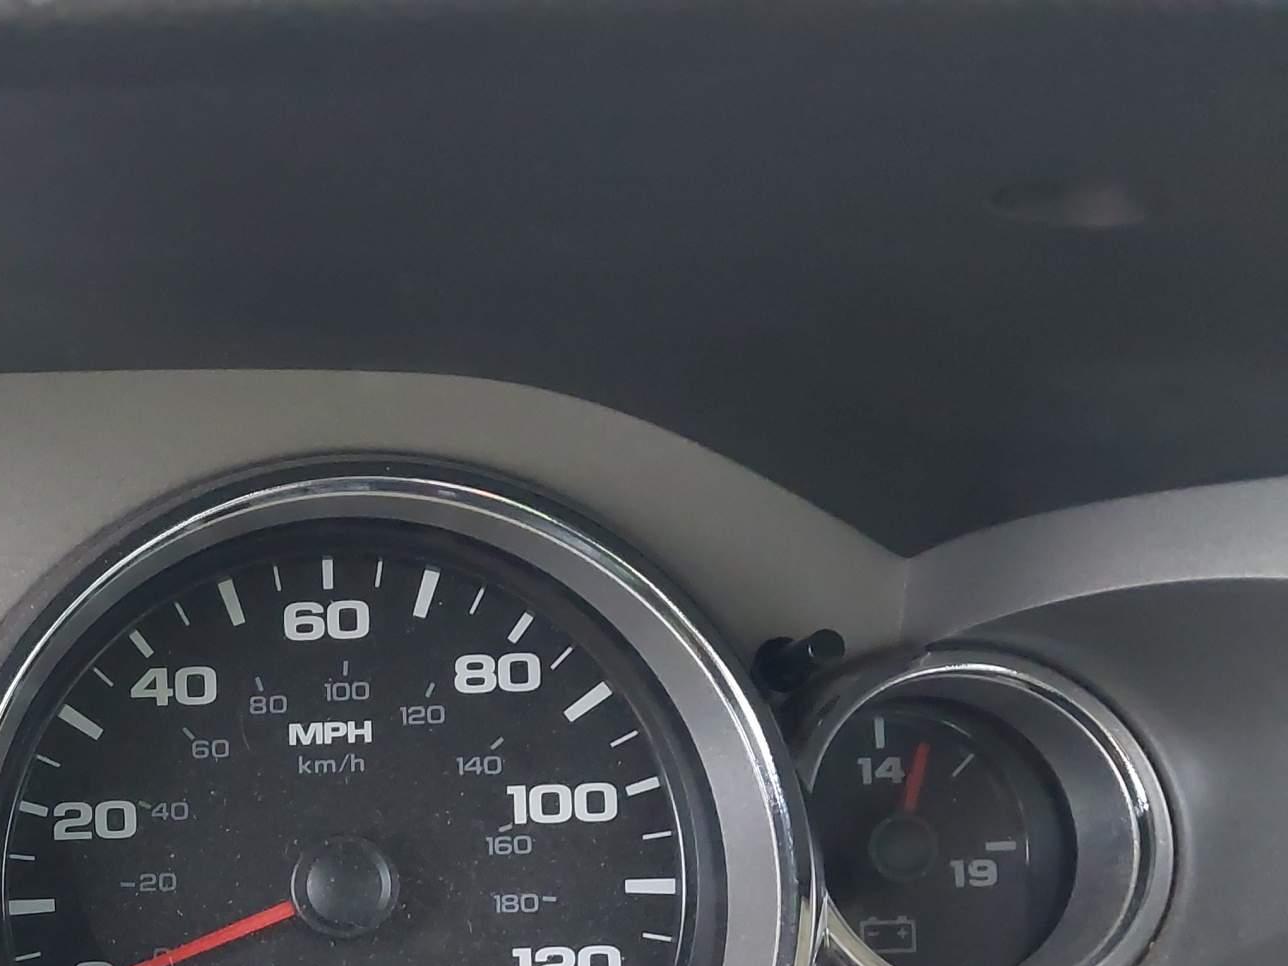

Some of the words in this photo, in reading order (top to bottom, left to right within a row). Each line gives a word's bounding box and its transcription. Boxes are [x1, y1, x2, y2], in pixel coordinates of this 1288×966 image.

[283, 600, 370, 642] 60
[454, 653, 541, 694] 80
[130, 666, 217, 707] 40
[324, 682, 370, 702] 100
[249, 695, 287, 715] 80
[400, 705, 445, 726] 120
[288, 720, 373, 746] MPH
[191, 739, 230, 759] 60
[298, 753, 365, 774] km/h
[456, 755, 503, 776] 140
[857, 756, 906, 785] 14
[151, 802, 189, 821] 40
[506, 782, 618, 825] 100
[53, 800, 137, 841] 20
[485, 835, 533, 856] 160
[139, 872, 177, 892] 20
[949, 858, 998, 889] 19
[493, 894, 540, 914] 180
